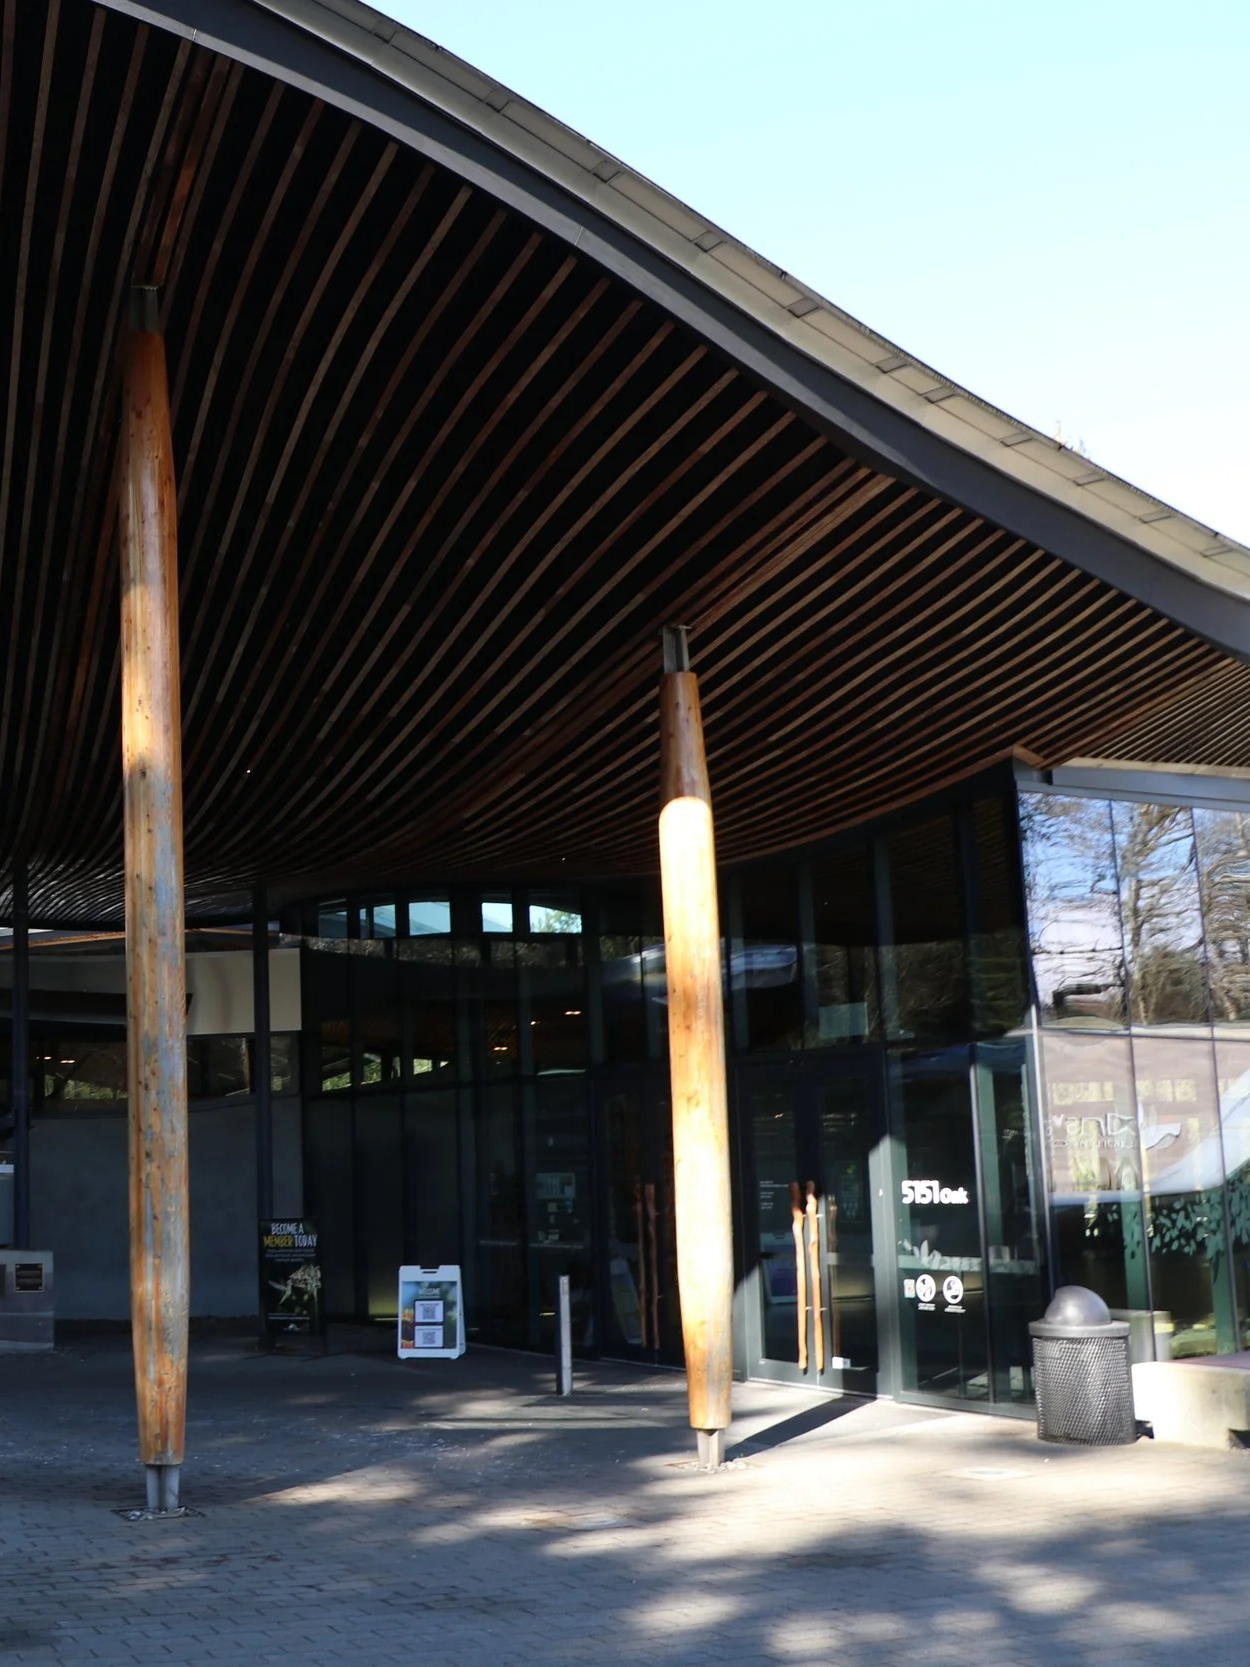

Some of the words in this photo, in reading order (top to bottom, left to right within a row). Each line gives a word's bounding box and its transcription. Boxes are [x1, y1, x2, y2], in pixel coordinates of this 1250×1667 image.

[901, 1179, 940, 1205] 5151
[940, 1186, 969, 1205] Oak
[271, 1222, 298, 1235] BECOME
[263, 1235, 294, 1248] MEMBER
[294, 1234, 318, 1248] TODAY
